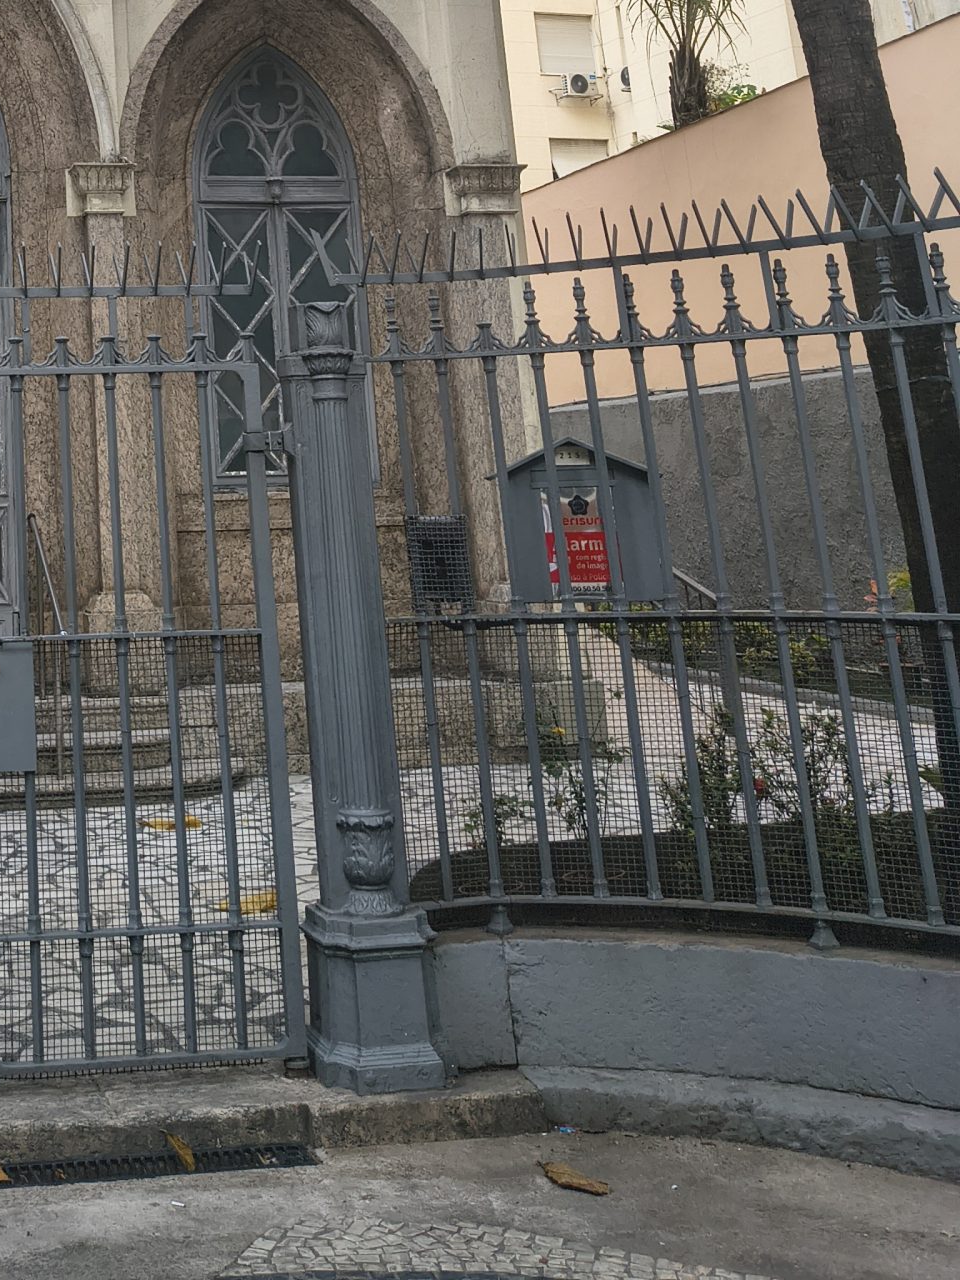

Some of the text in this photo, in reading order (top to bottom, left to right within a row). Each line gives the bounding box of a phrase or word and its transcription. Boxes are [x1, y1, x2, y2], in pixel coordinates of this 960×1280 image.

[562, 516, 603, 526] erisur
[590, 553, 607, 561] regi
[586, 561, 608, 570] imag
